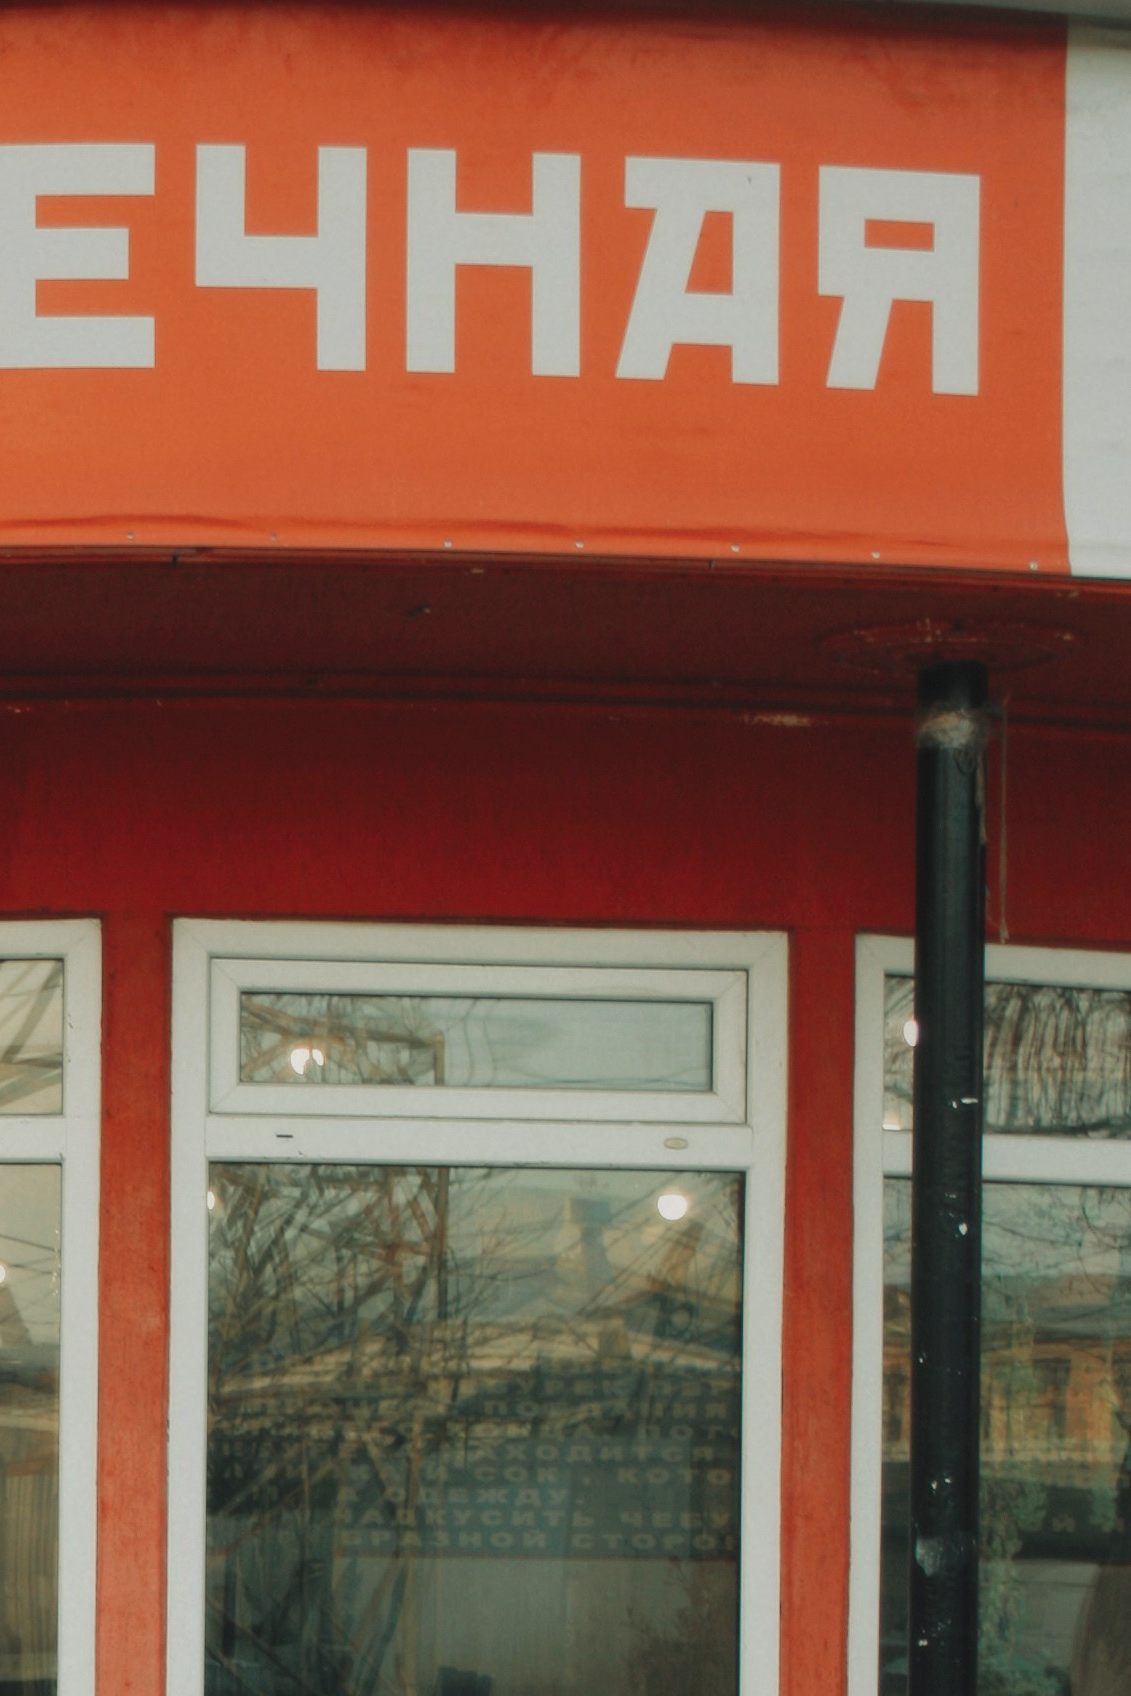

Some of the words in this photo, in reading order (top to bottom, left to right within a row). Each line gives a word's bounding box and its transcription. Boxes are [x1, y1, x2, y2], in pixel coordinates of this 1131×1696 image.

[473, 1467, 558, 1486] СОК
[385, 1487, 585, 1507] ОДЕЖДУ.
[332, 1509, 596, 1529] НАДКУСИТЬ
[340, 1530, 547, 1549] БРАЗНОЙ
